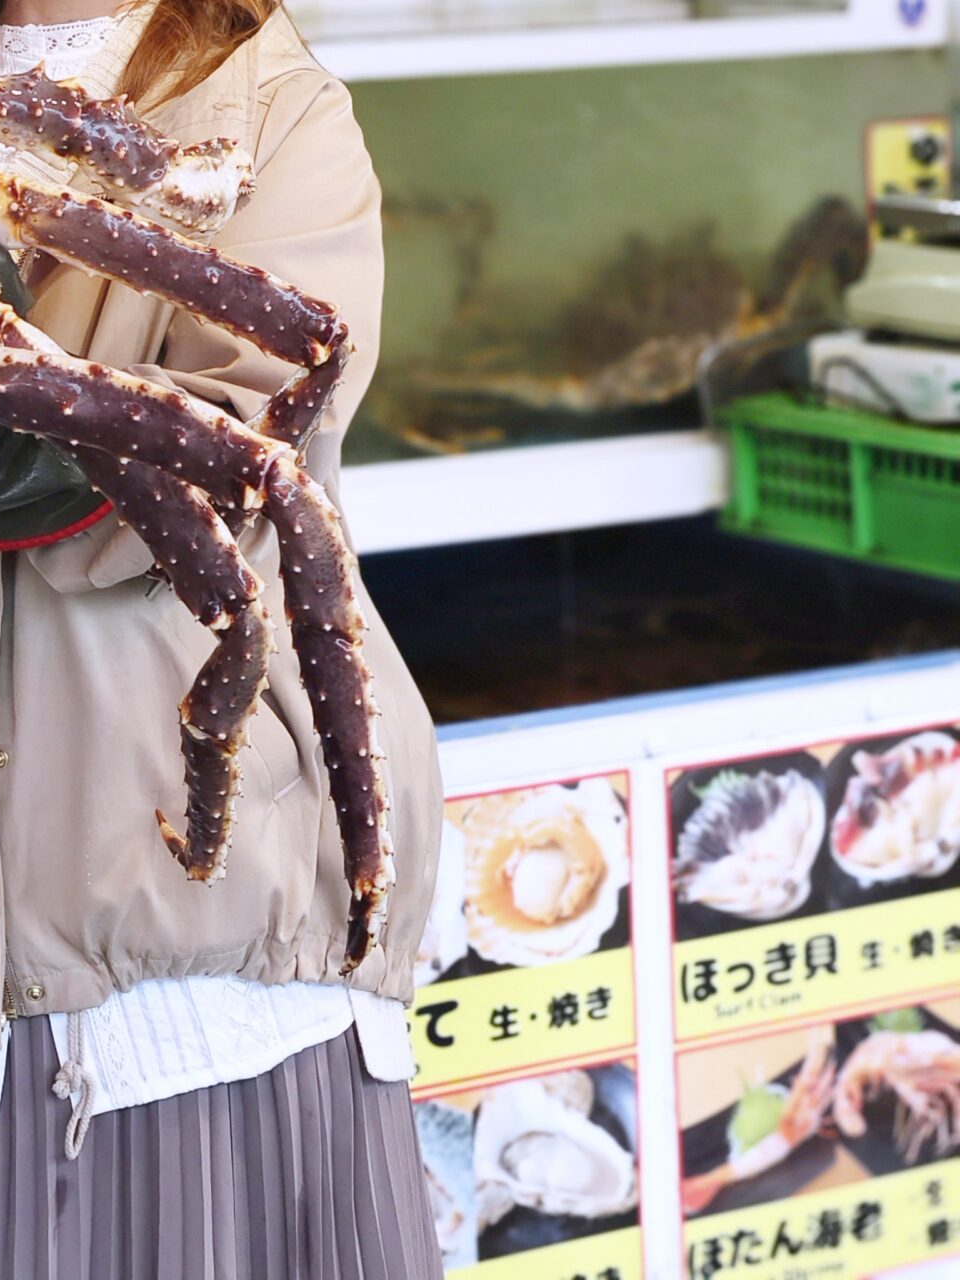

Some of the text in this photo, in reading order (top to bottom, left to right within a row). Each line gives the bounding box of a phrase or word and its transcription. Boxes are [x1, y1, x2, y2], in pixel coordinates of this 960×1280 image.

[681, 933, 838, 1004] ほっき貝
[490, 987, 612, 1042] 生・焼き
